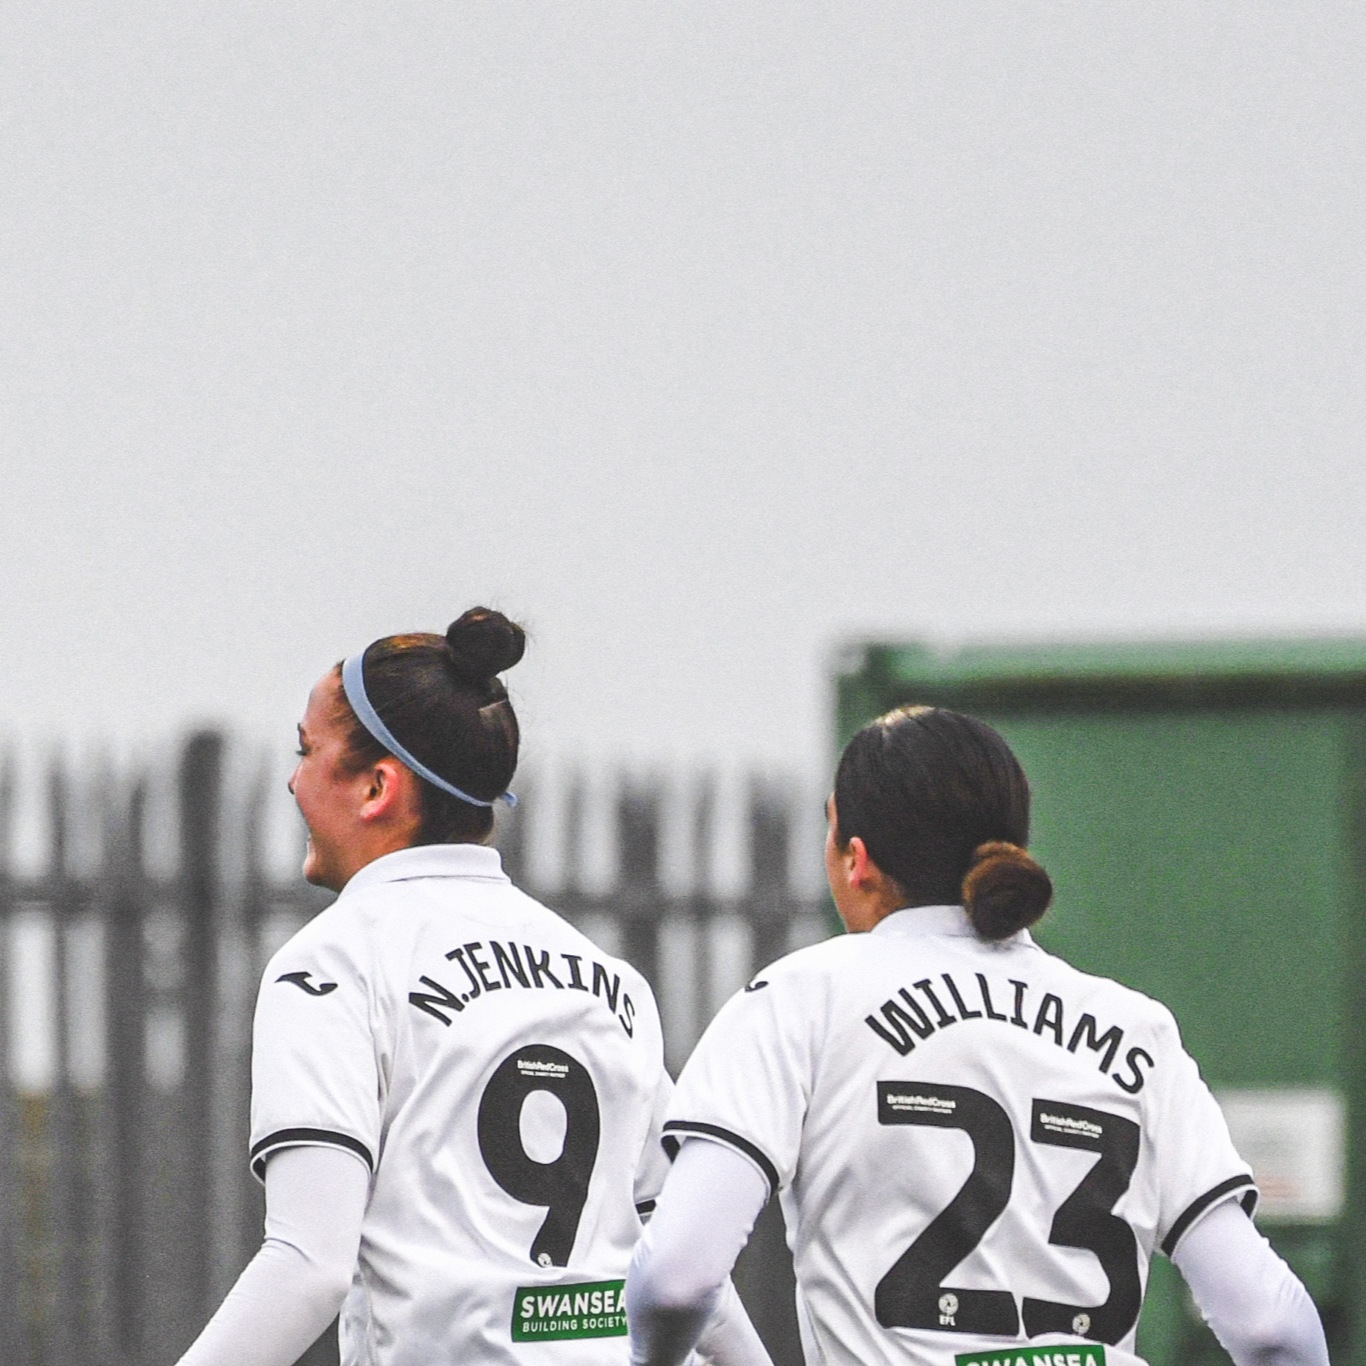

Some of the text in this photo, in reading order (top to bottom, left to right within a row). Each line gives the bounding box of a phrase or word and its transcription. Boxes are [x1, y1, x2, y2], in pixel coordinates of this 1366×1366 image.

[408, 940, 635, 1039] N.JENKINS
[864, 972, 1155, 1094] WILLIAMS
[477, 1043, 601, 1268] 9
[875, 1080, 1141, 1345] 23
[520, 1288, 627, 1319] SWANSEA
[522, 1320, 577, 1332] BUILDING
